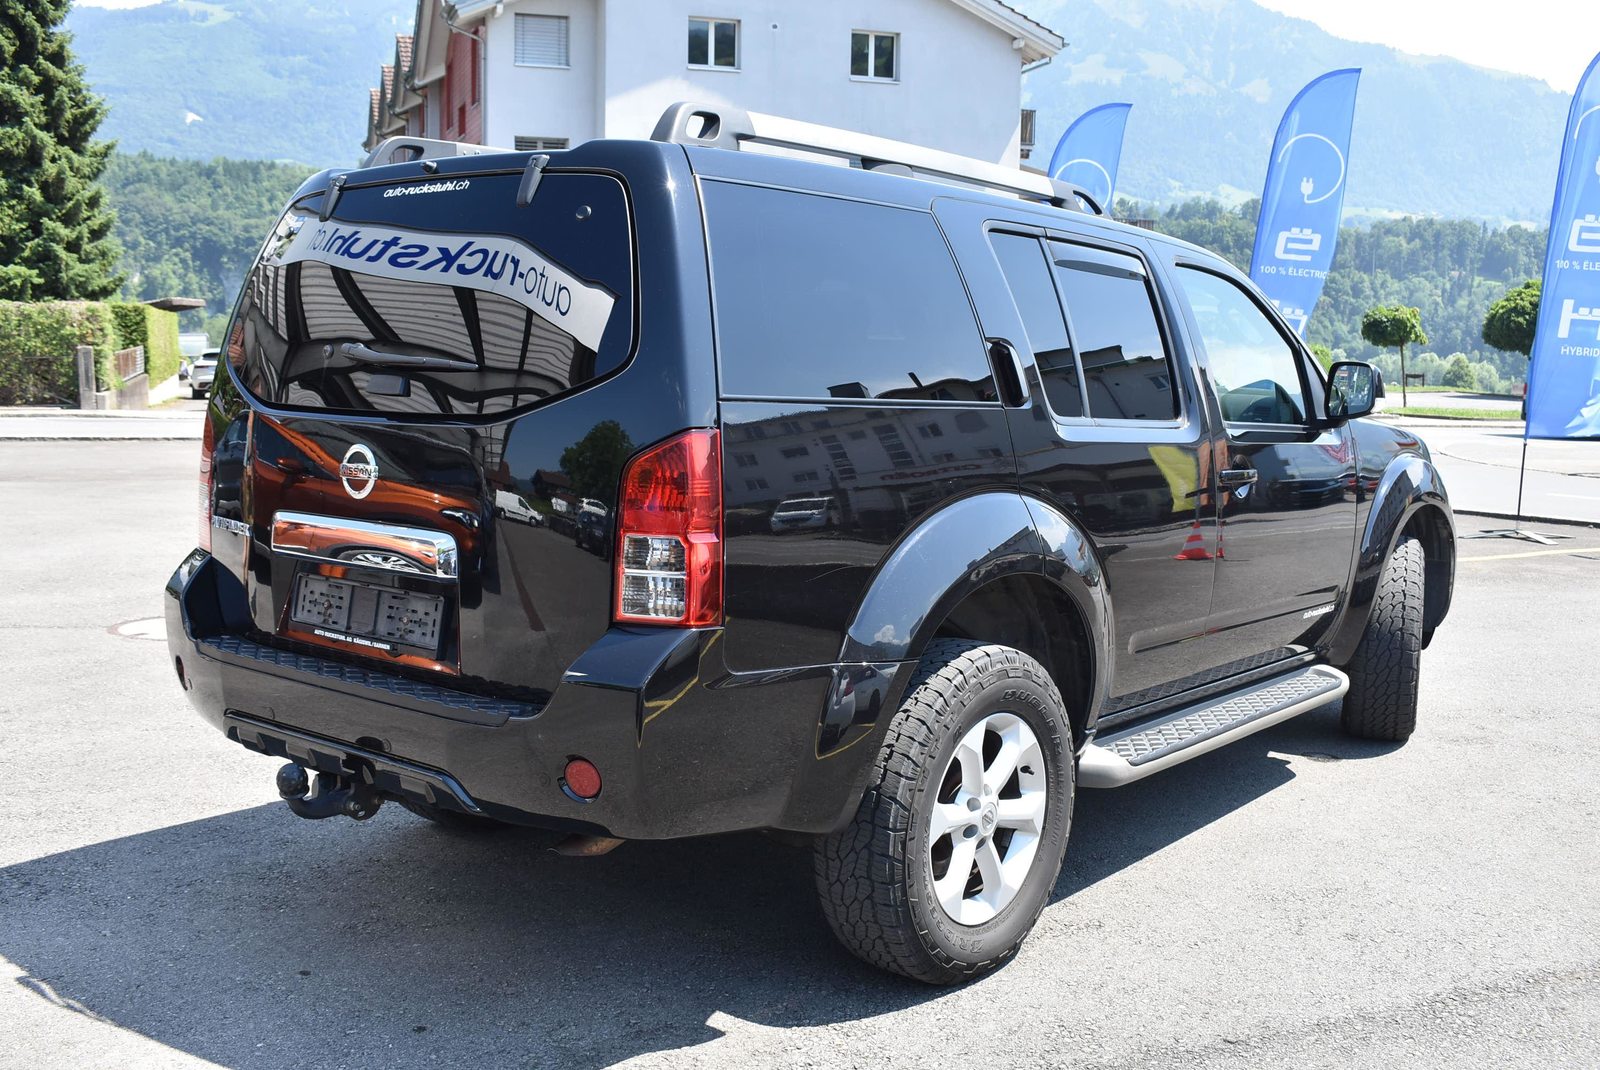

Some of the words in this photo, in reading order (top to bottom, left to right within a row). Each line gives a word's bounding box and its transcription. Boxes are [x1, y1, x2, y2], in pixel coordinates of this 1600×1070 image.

[383, 180, 470, 197] auto-ruckstuhl.ch
[1260, 265, 1277, 274] 100
[341, 463, 373, 478] NISSAN
[1001, 689, 1064, 755] DUELER
